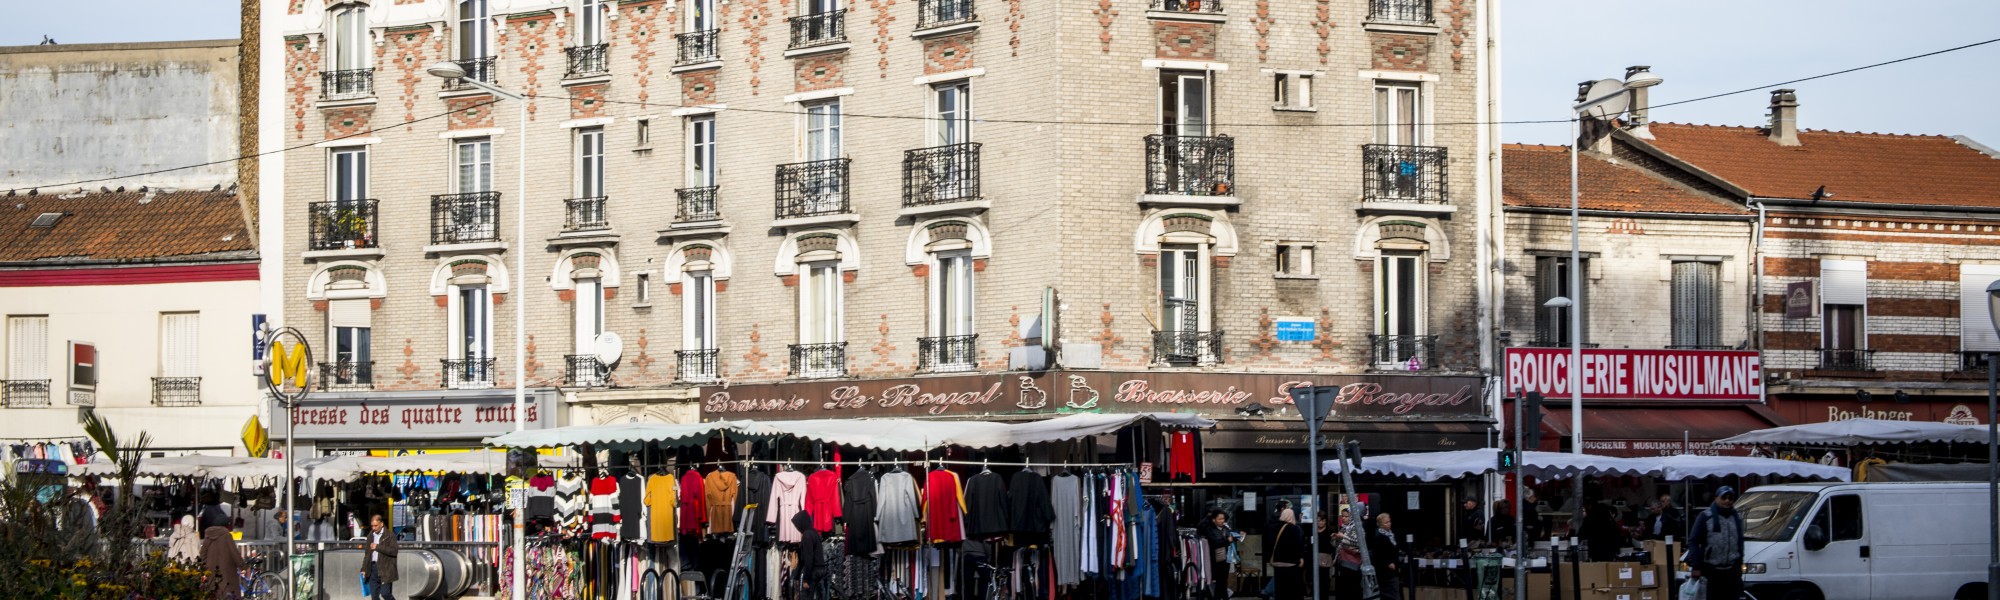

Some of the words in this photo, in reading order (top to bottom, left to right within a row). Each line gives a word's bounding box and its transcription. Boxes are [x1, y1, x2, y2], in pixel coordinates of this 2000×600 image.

[272, 341, 307, 388] M
[1634, 355, 1760, 395] MUSULMANE
[704, 391, 811, 414] Brasserie
[823, 386, 874, 410] Le
[878, 382, 1003, 415] Royal
[1114, 379, 1252, 405] Brasserie
[1334, 382, 1472, 414] Royal
[359, 402, 390, 425] des
[401, 403, 462, 430] quatre
[475, 402, 538, 423] routs
[1583, 441, 1627, 450] OUCHERIE
[1633, 441, 1682, 450] MUSULMANE
